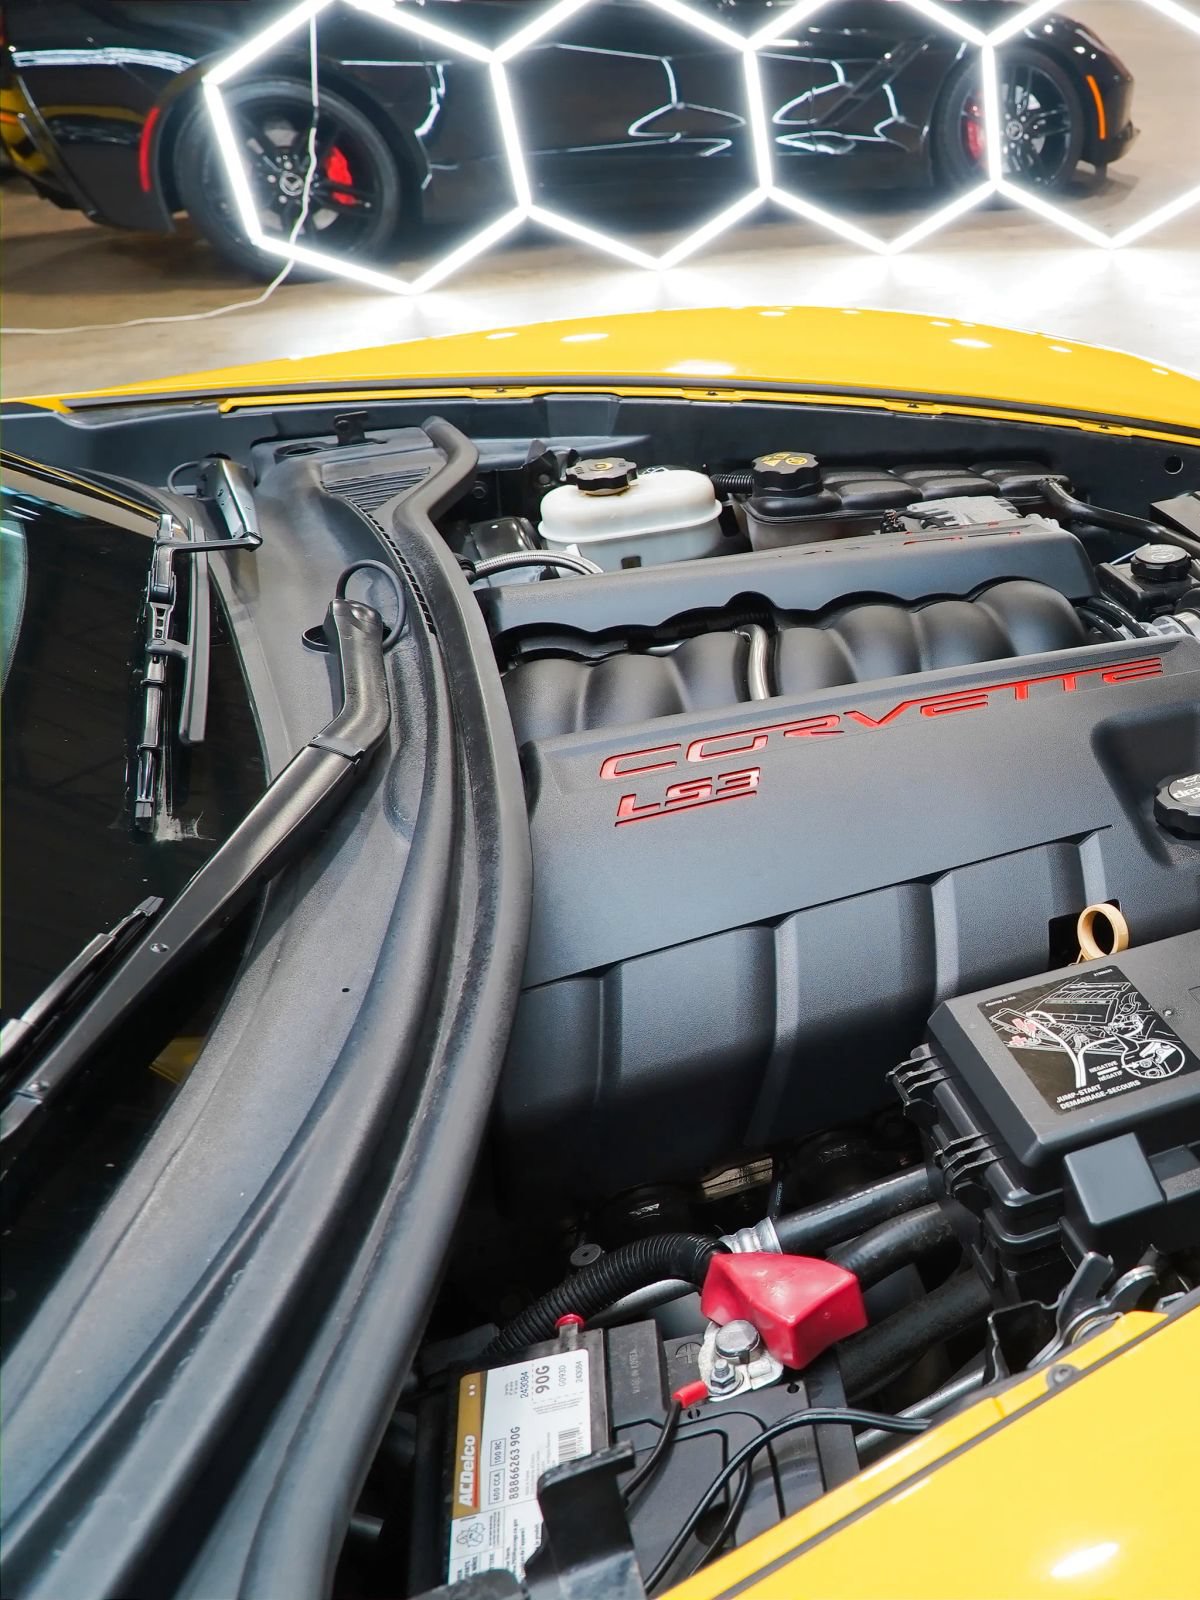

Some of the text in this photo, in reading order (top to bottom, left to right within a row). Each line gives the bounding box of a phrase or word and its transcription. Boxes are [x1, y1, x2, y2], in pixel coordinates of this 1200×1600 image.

[600, 657, 1163, 781] CORVETTE
[617, 767, 760, 818] LS3
[1088, 1060, 1119, 1074] NEGATIVE
[1056, 1083, 1101, 1104] JUMP-START
[535, 1365, 550, 1394] 90G
[495, 1440, 502, 1450] RC
[509, 1426, 521, 1500] 88866263 90G
[458, 1434, 476, 1507] ACDelco
